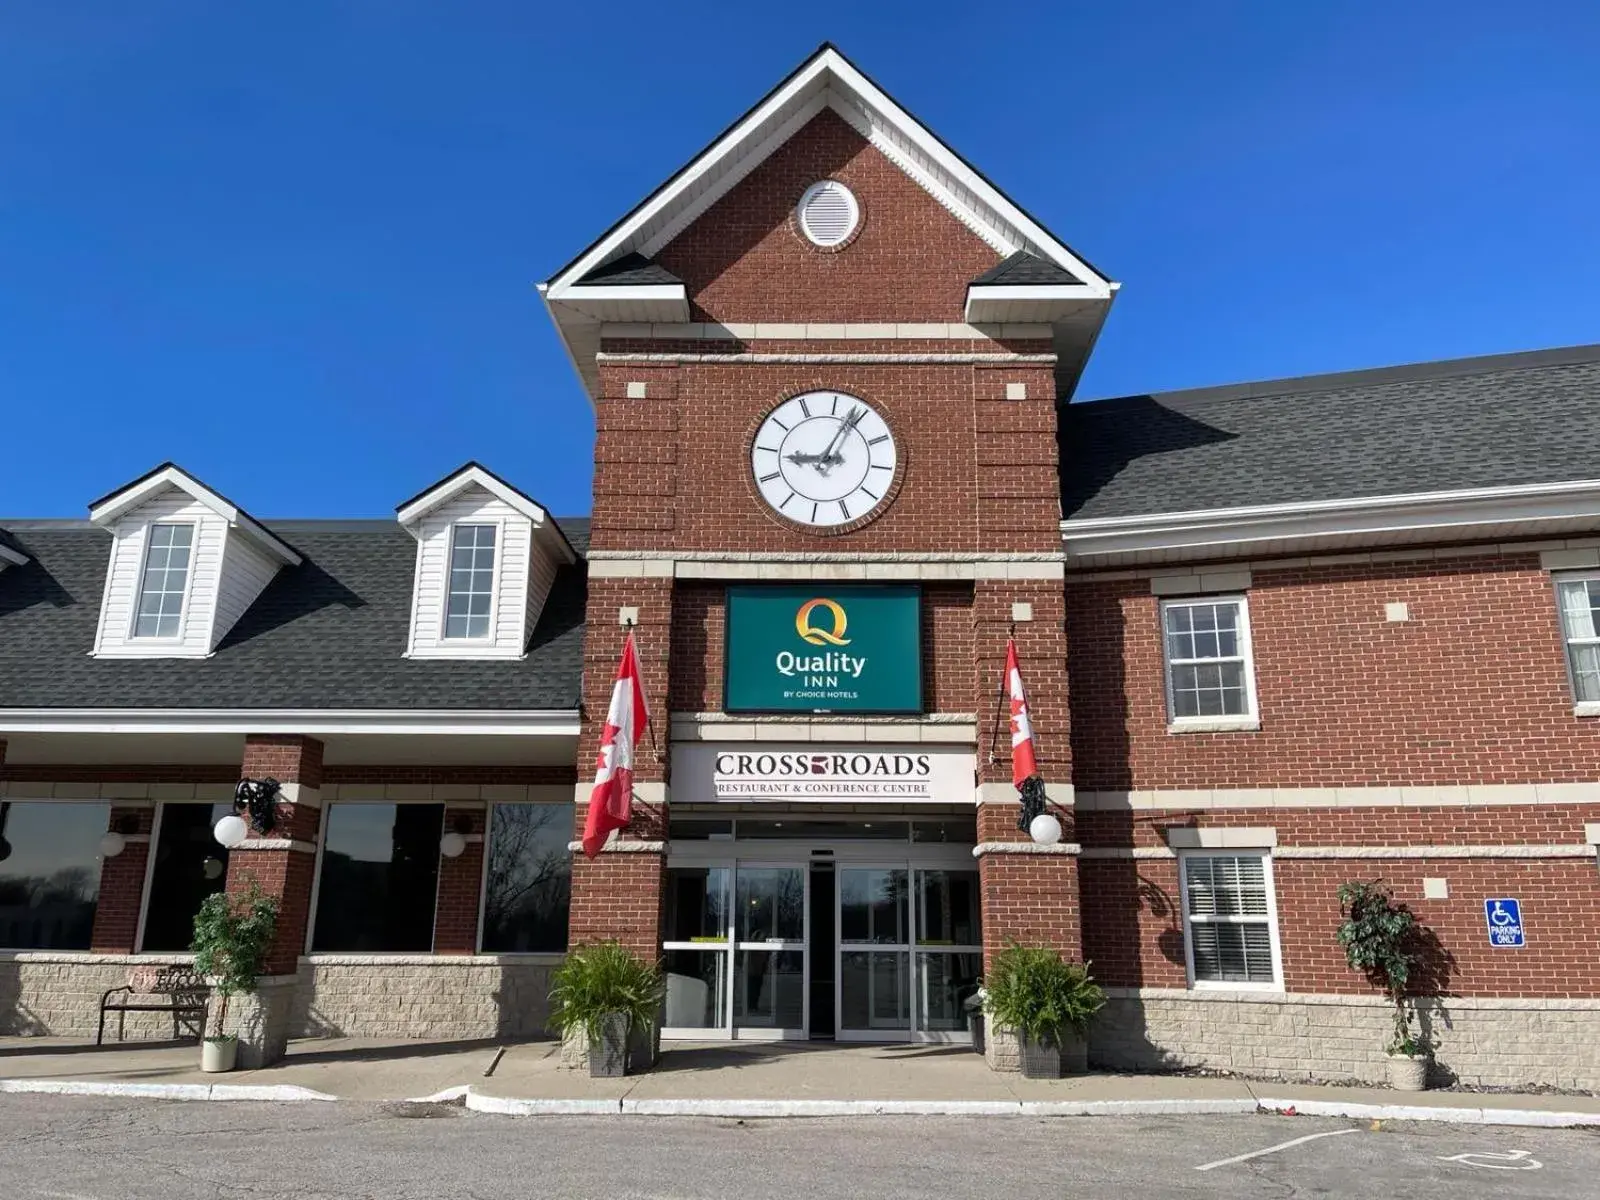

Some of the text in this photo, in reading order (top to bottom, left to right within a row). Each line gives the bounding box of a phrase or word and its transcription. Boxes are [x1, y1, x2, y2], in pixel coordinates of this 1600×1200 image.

[776, 651, 866, 678] Quality
[804, 676, 838, 688] INN
[827, 691, 858, 699] HOTELS
[719, 784, 928, 793] RESTAURANT & CONFERENCE CENTRE
[1491, 925, 1521, 935] PARKING
[1497, 934, 1516, 944] ONLY
